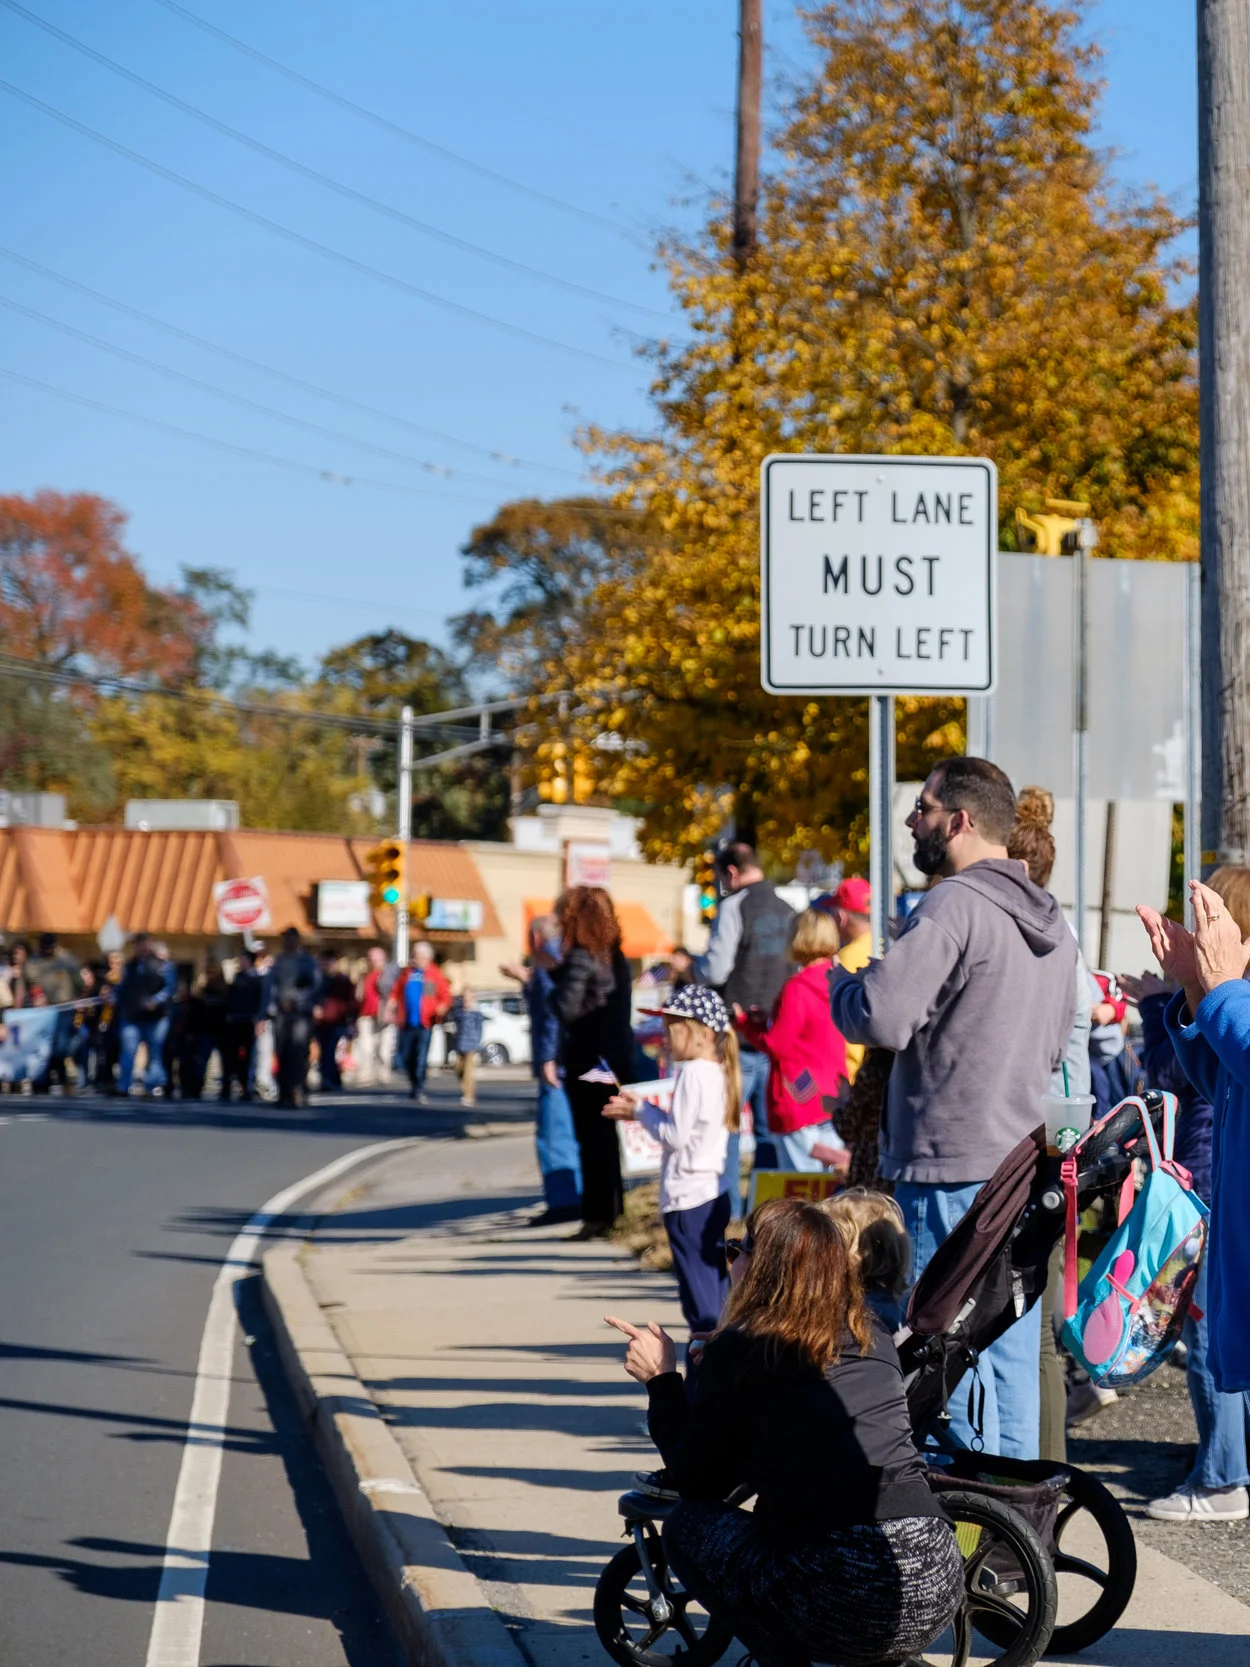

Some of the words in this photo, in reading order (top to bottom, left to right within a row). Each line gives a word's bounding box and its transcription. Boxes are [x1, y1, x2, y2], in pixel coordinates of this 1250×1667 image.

[788, 488, 869, 523] LEFT
[891, 490, 975, 526] LANE
[822, 553, 941, 597] MUST
[789, 623, 876, 659] TURN
[896, 626, 975, 661] LEFT
